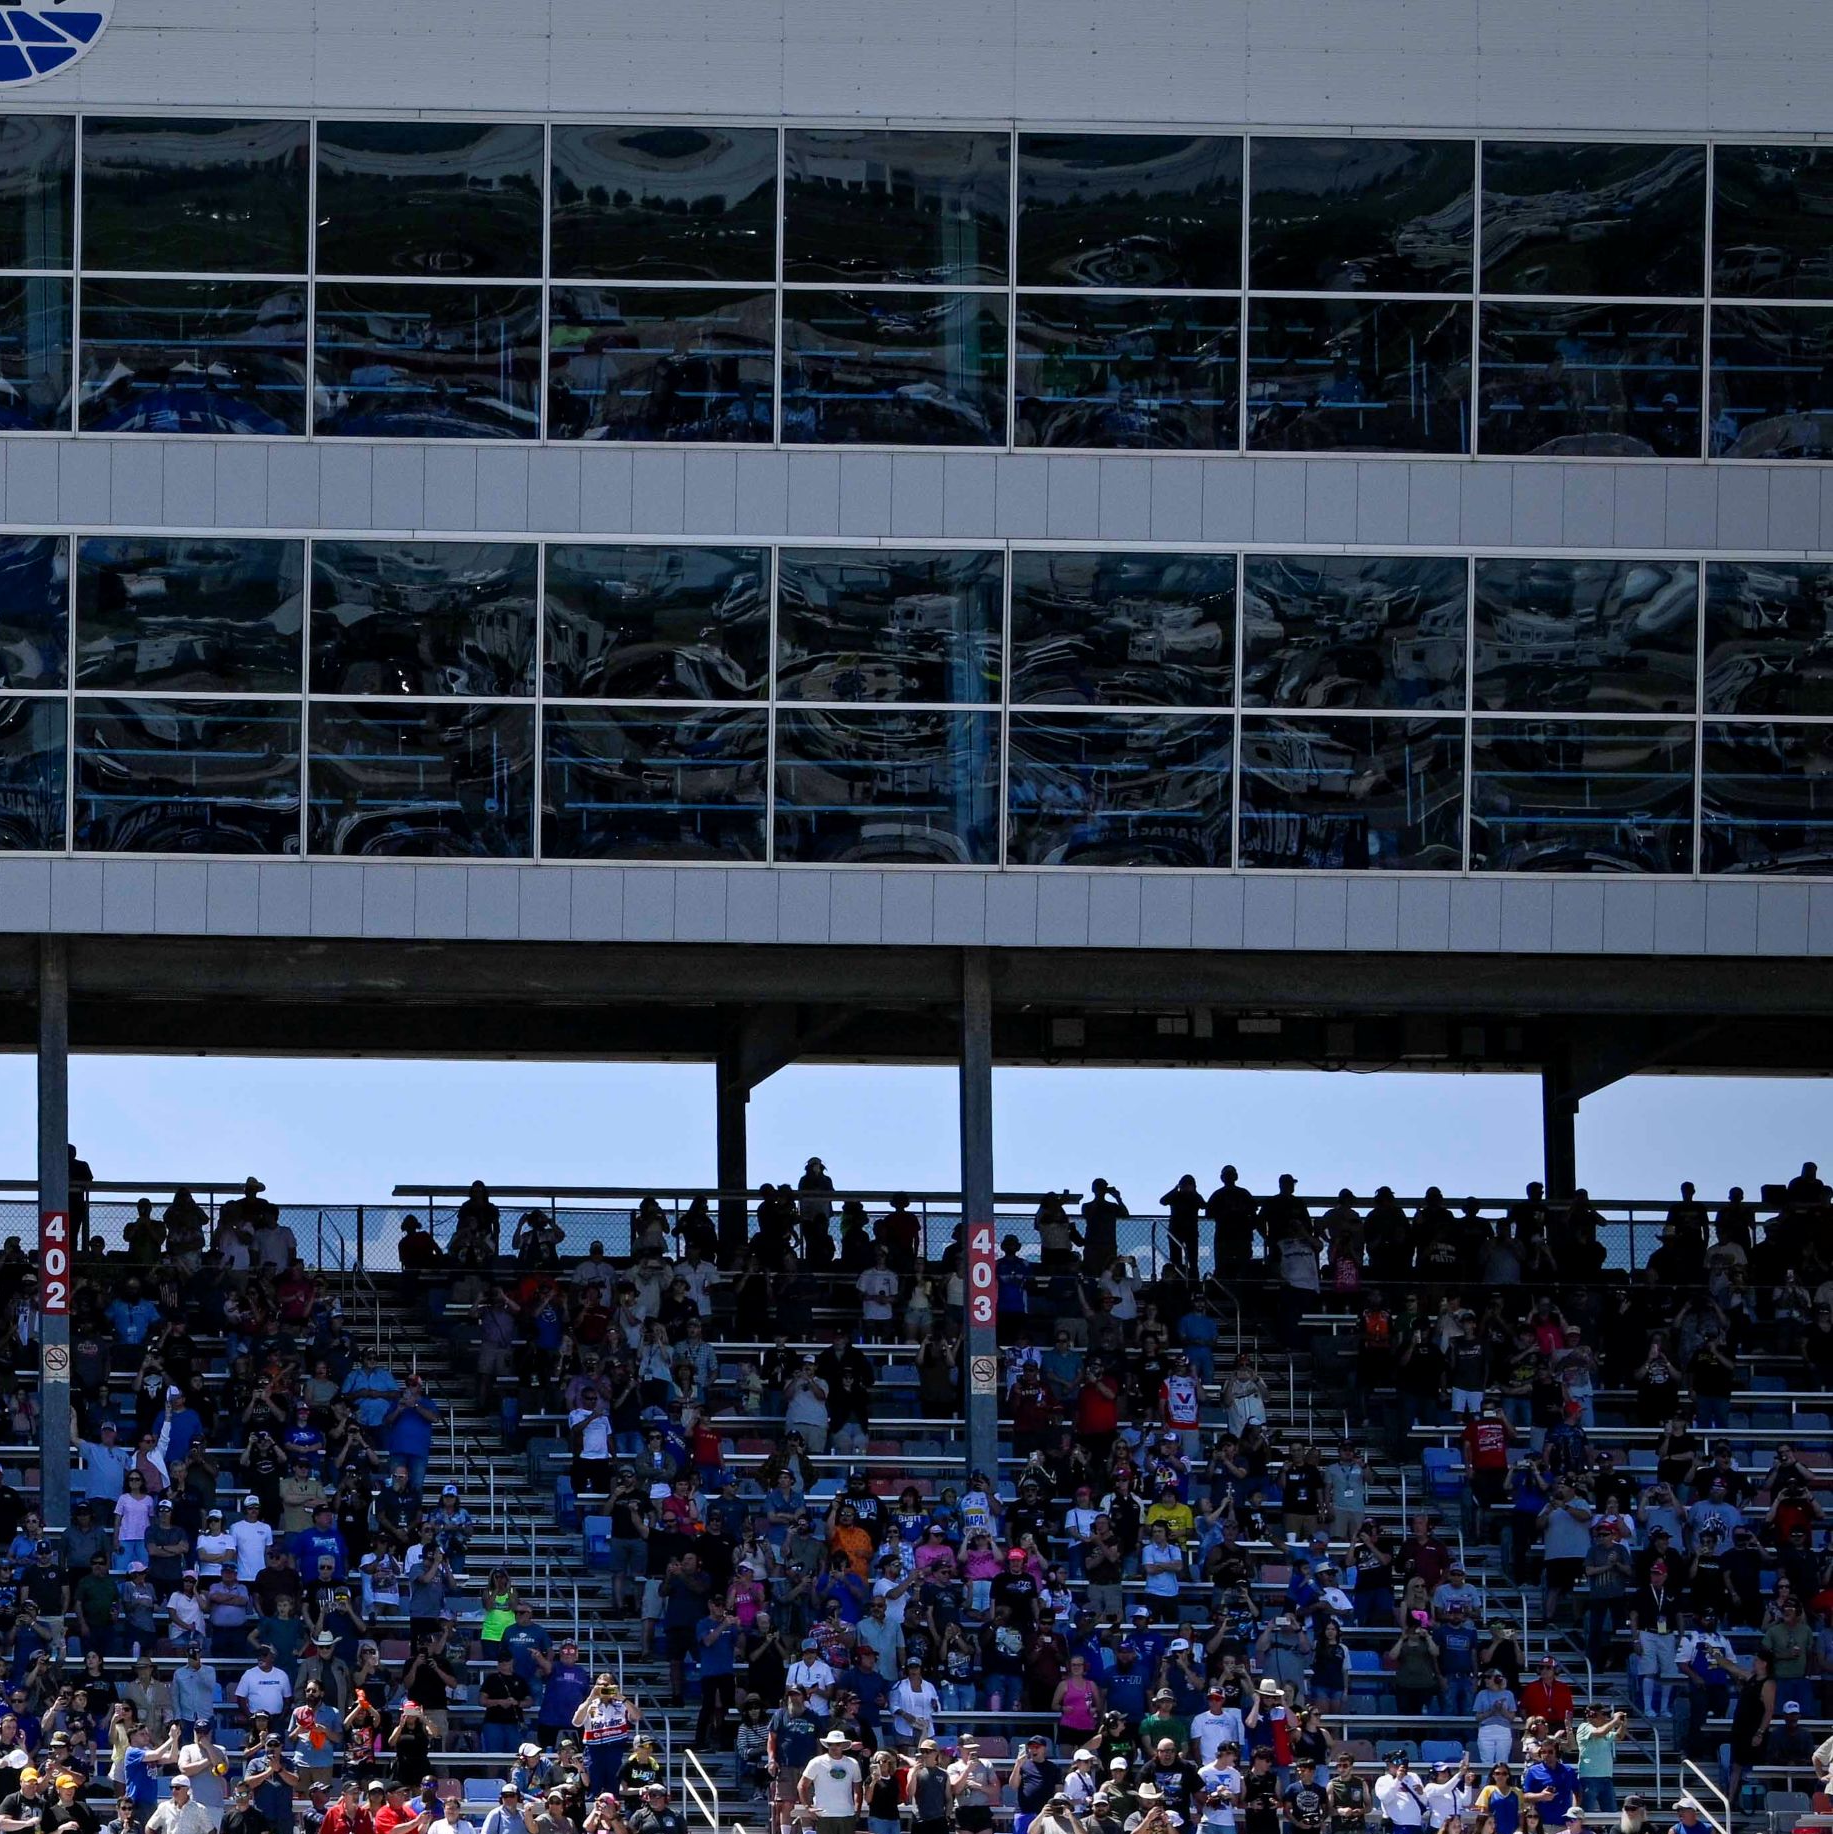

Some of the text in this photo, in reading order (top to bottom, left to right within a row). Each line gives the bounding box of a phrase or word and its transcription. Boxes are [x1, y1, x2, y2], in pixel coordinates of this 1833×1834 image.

[45, 1215, 66, 1309] 402
[972, 1229, 992, 1322] 403
[966, 1515, 984, 1526] NAPA
[590, 1717, 622, 1731] Valvoline
